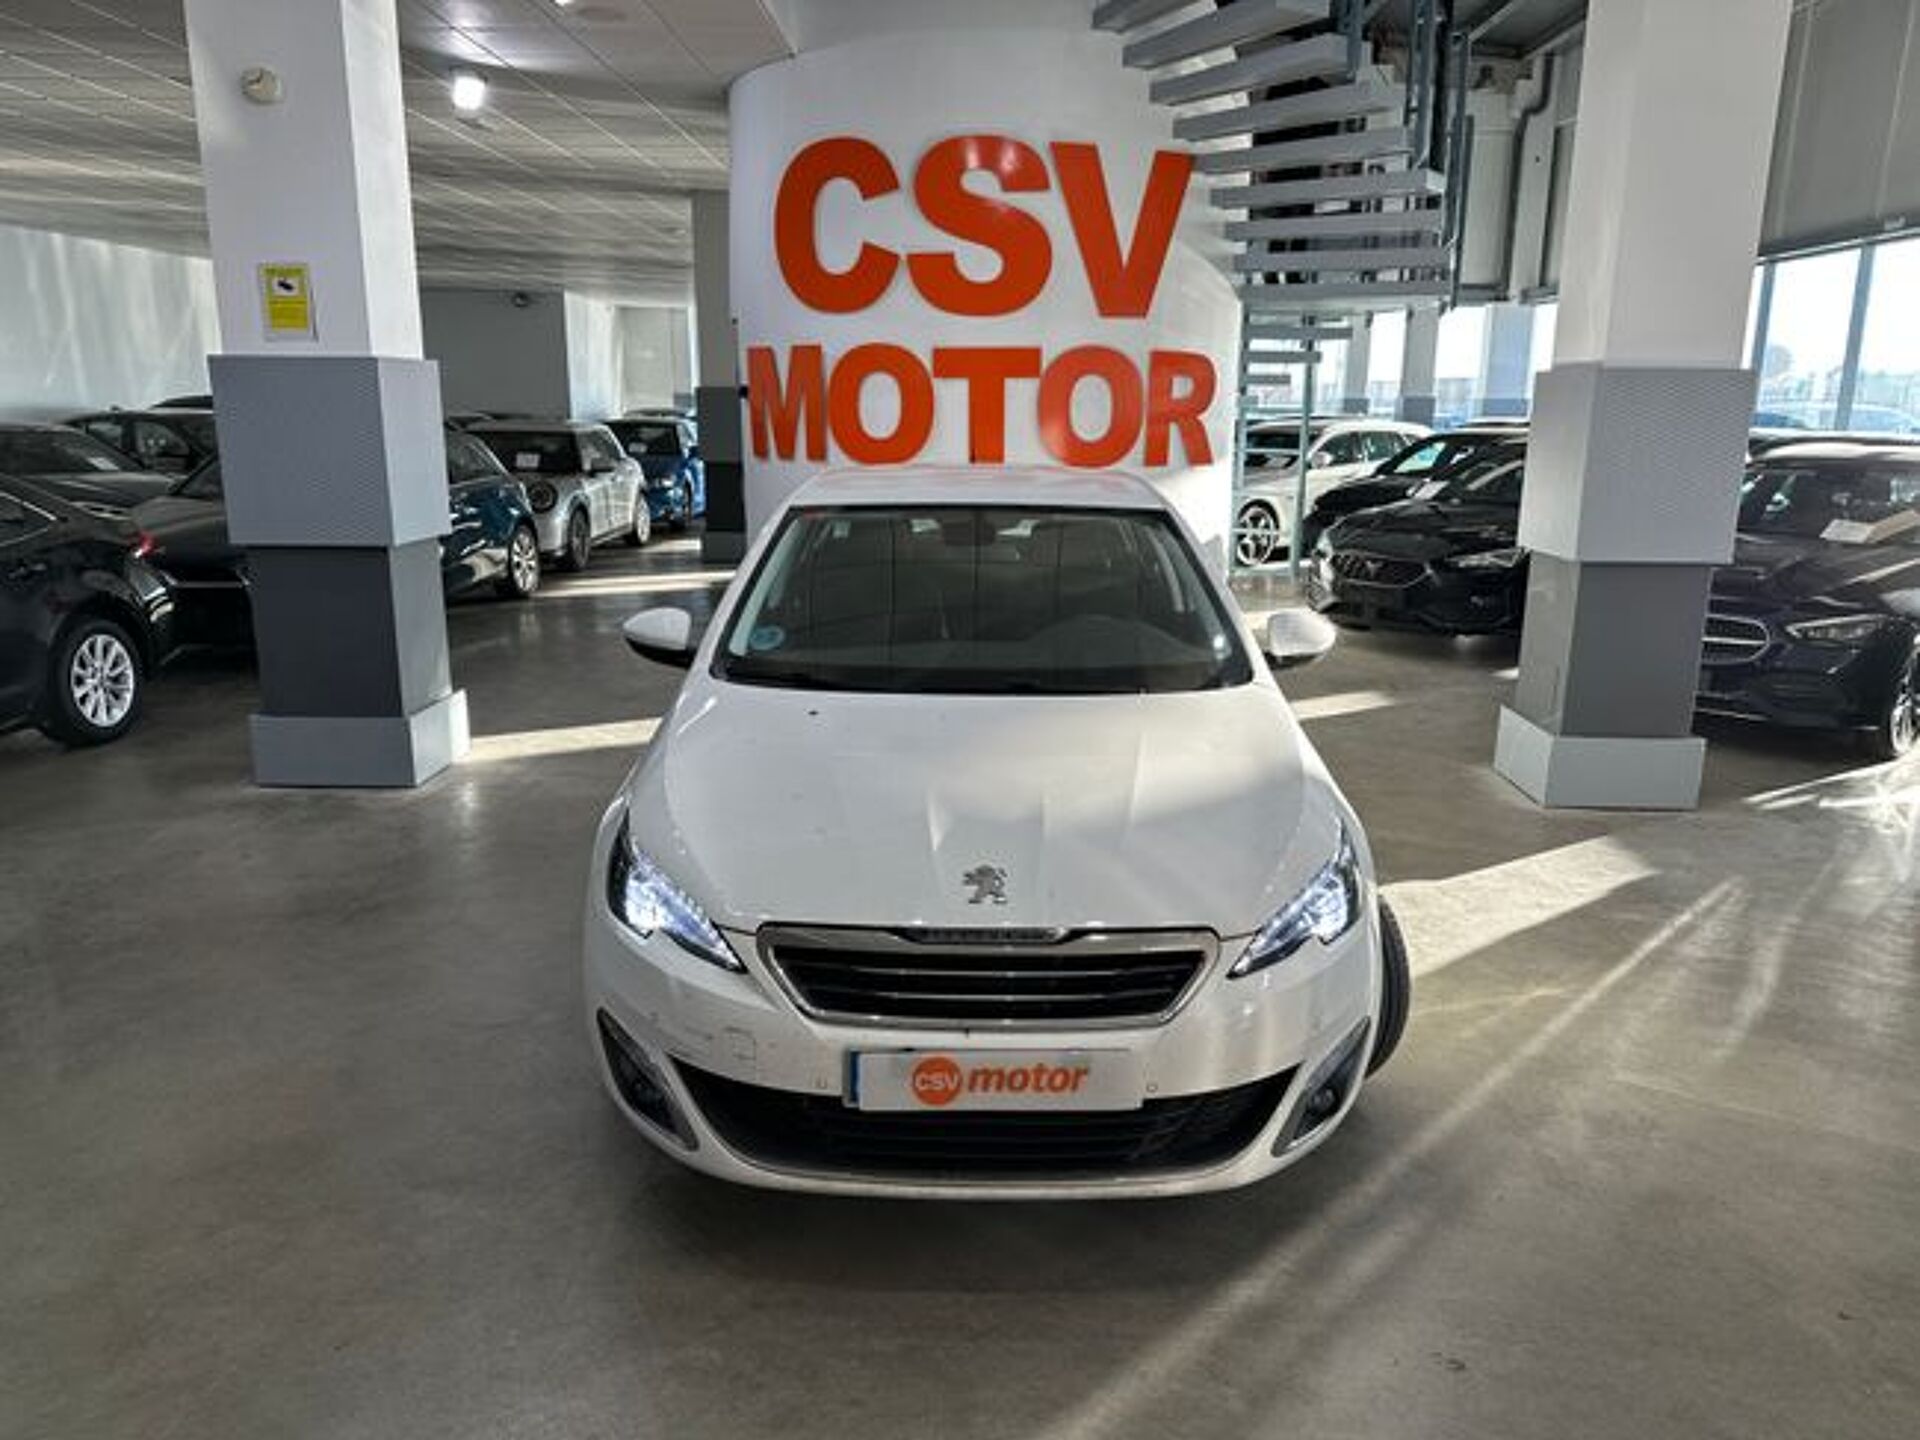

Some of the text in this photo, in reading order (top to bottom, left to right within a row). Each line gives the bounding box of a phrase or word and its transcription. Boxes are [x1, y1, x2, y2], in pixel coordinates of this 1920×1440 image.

[774, 135, 1195, 318] CSV
[747, 342, 1216, 468] MOTOR
[968, 1062, 1088, 1093] motor
